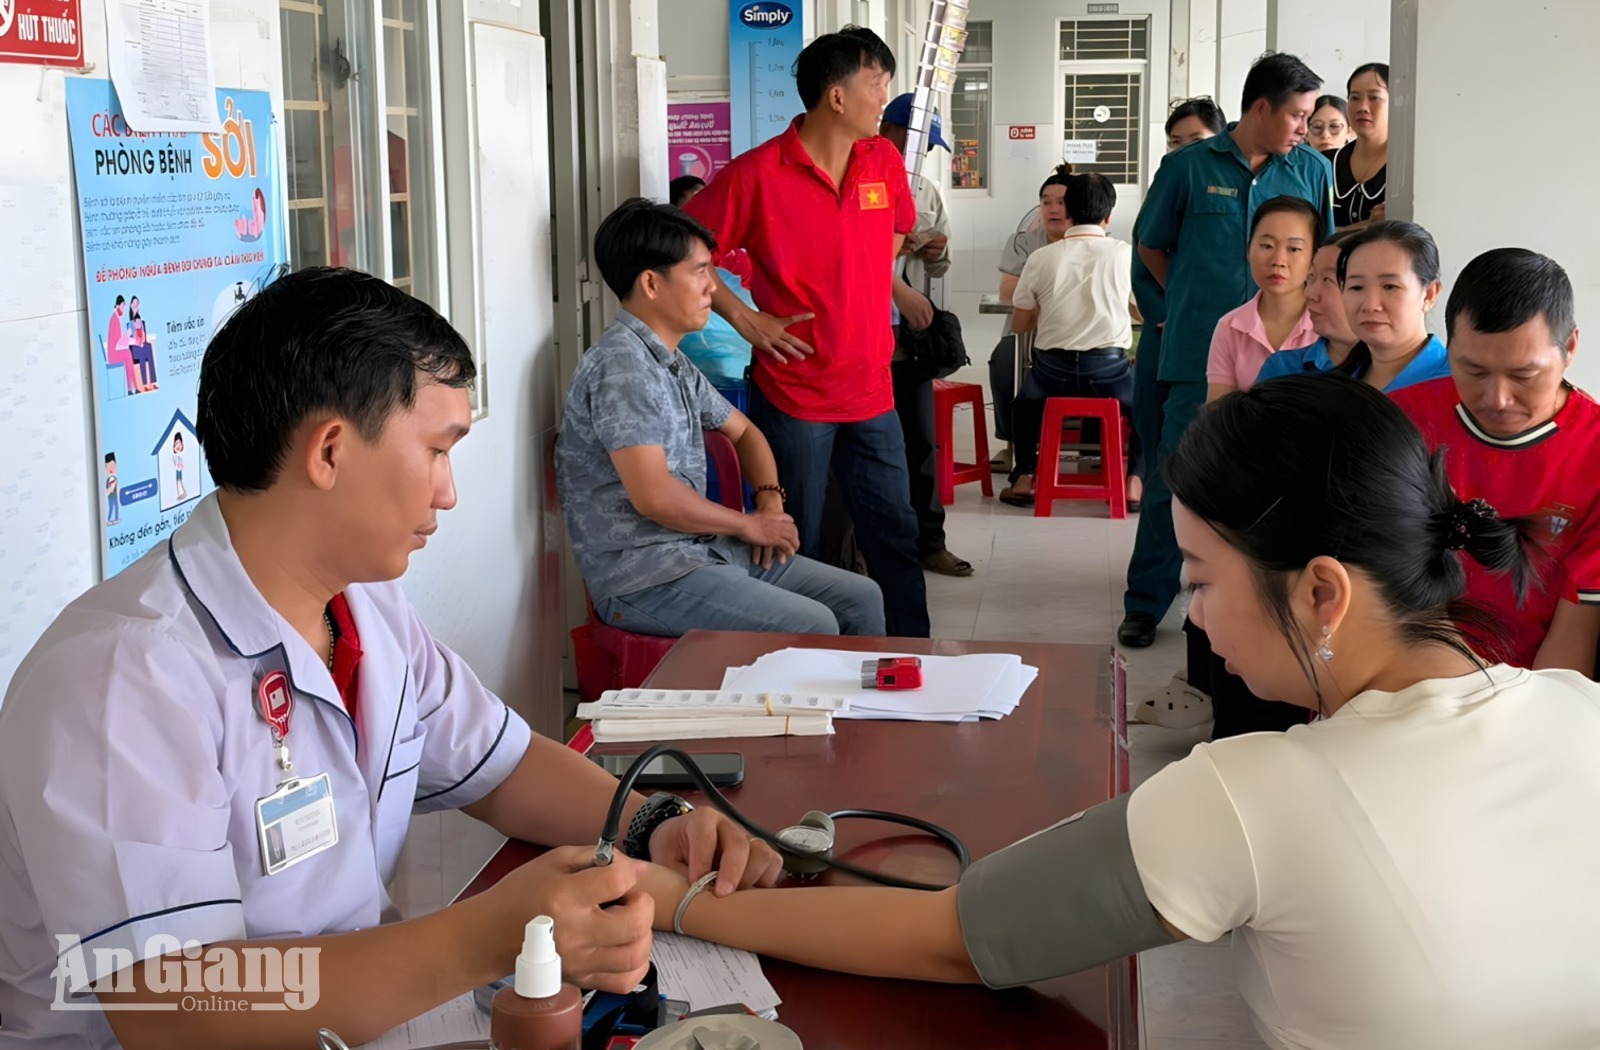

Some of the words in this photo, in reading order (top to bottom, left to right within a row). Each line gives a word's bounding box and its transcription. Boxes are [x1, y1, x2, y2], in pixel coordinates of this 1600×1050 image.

[17, 8, 39, 41] HÚT
[41, 8, 76, 45] THUỐC
[744, 5, 791, 24] Simply
[92, 109, 120, 137] CÁC
[202, 96, 257, 180] SỞI
[95, 142, 154, 175] PHÒNG
[158, 142, 192, 181] BỆNH
[109, 531, 135, 549] Không
[137, 522, 153, 539] đến
